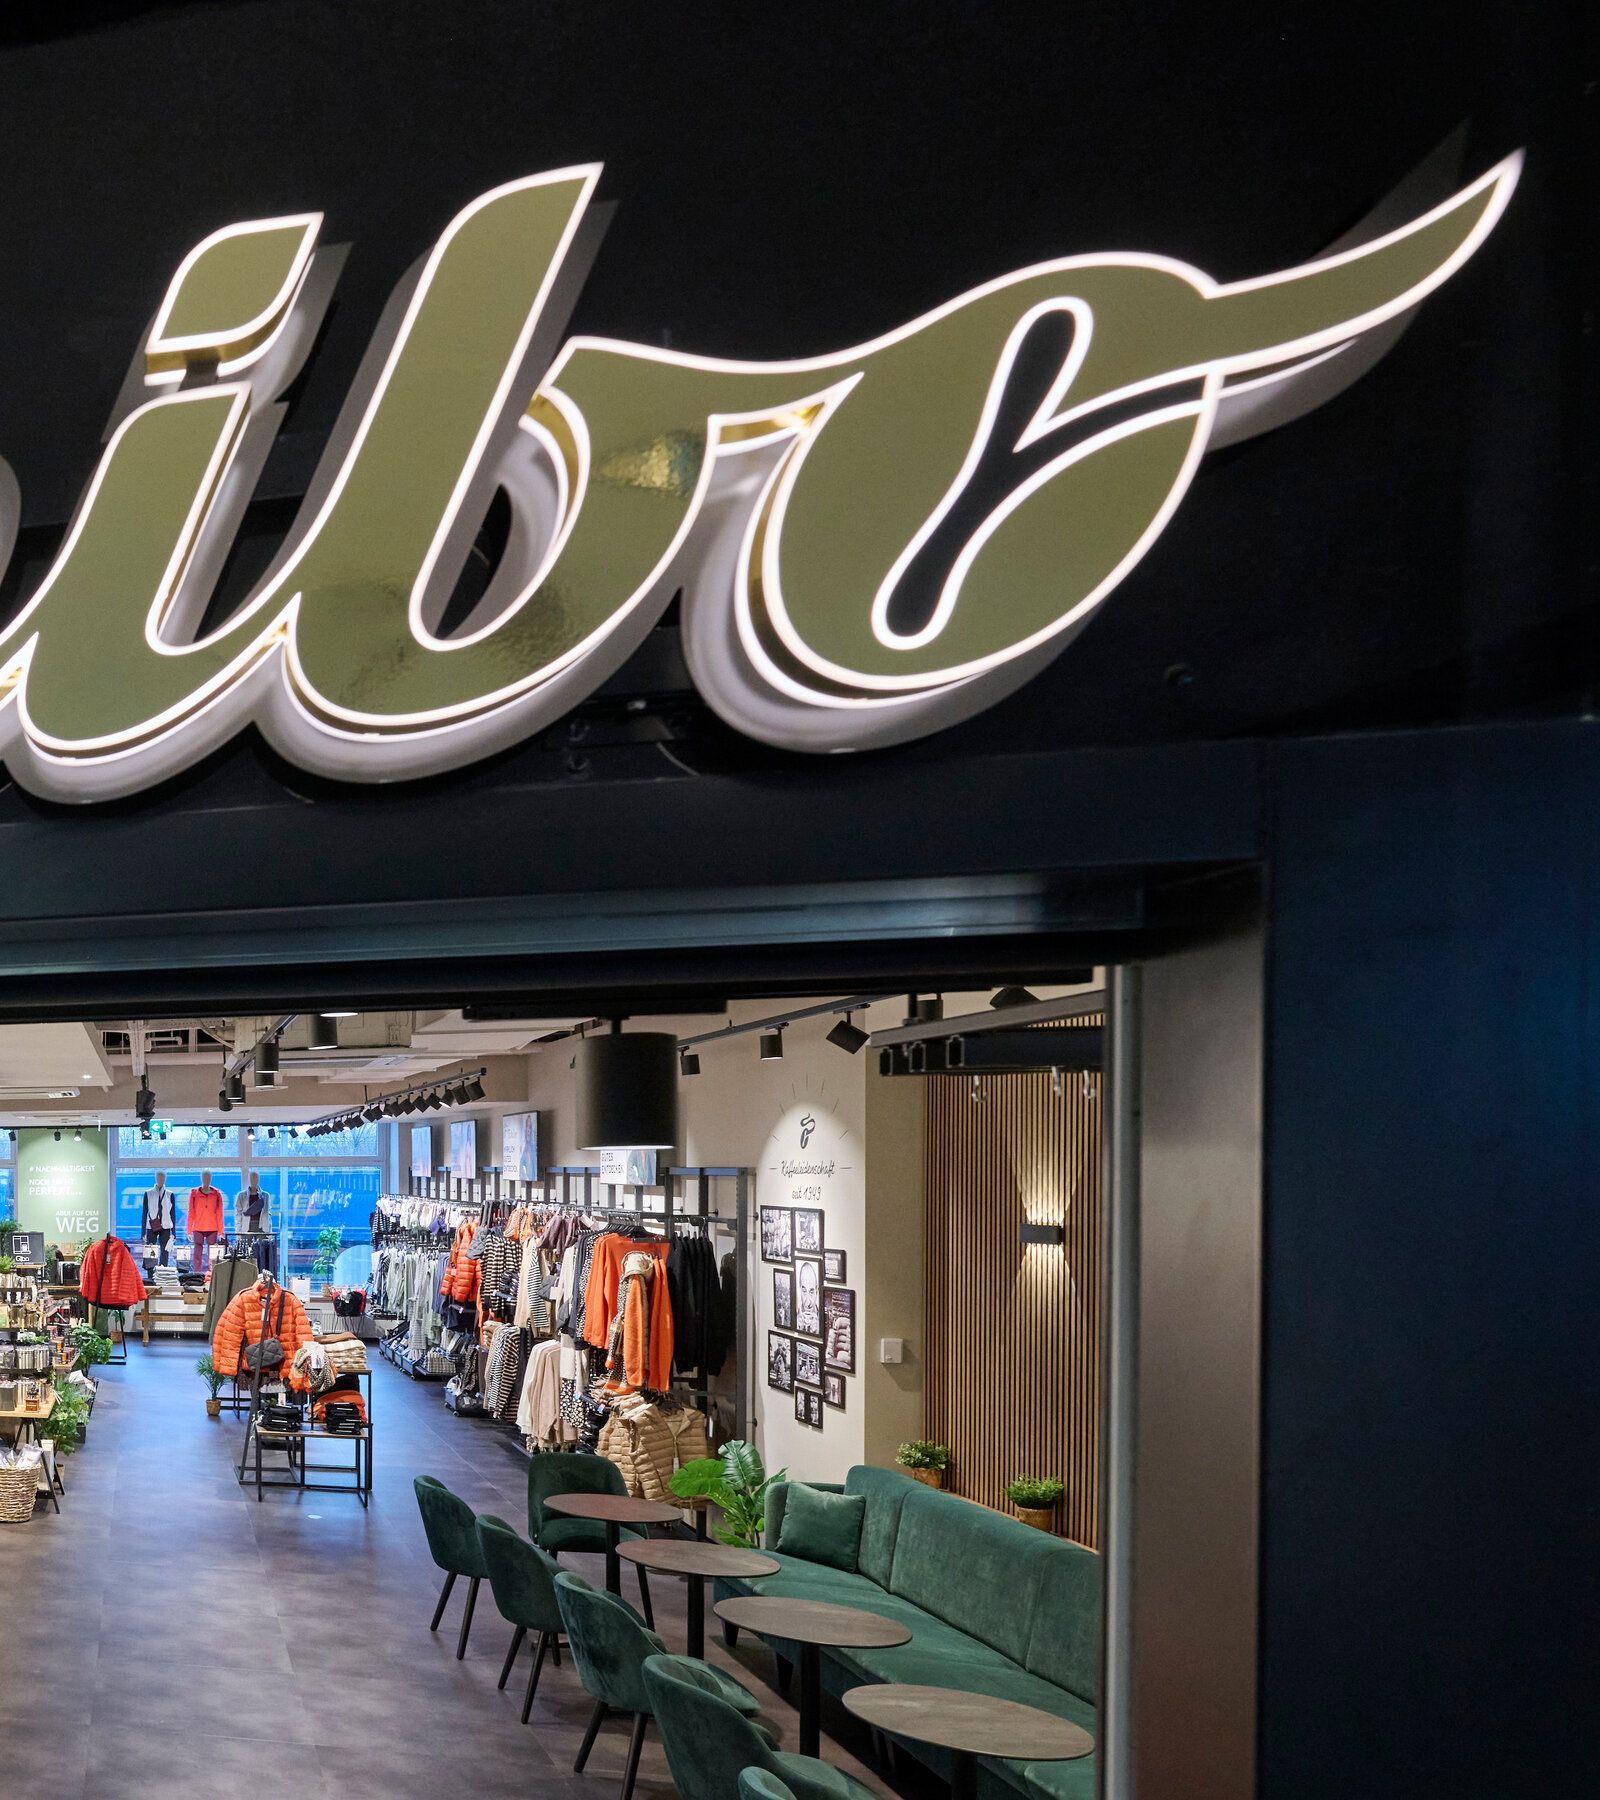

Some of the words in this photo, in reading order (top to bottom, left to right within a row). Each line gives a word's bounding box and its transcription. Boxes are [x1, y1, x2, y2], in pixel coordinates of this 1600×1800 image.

[781, 1160, 834, 1178] Kaffeeleidenschaft
[803, 1186, 821, 1200] 1949
[56, 1217, 99, 1232] WEG
